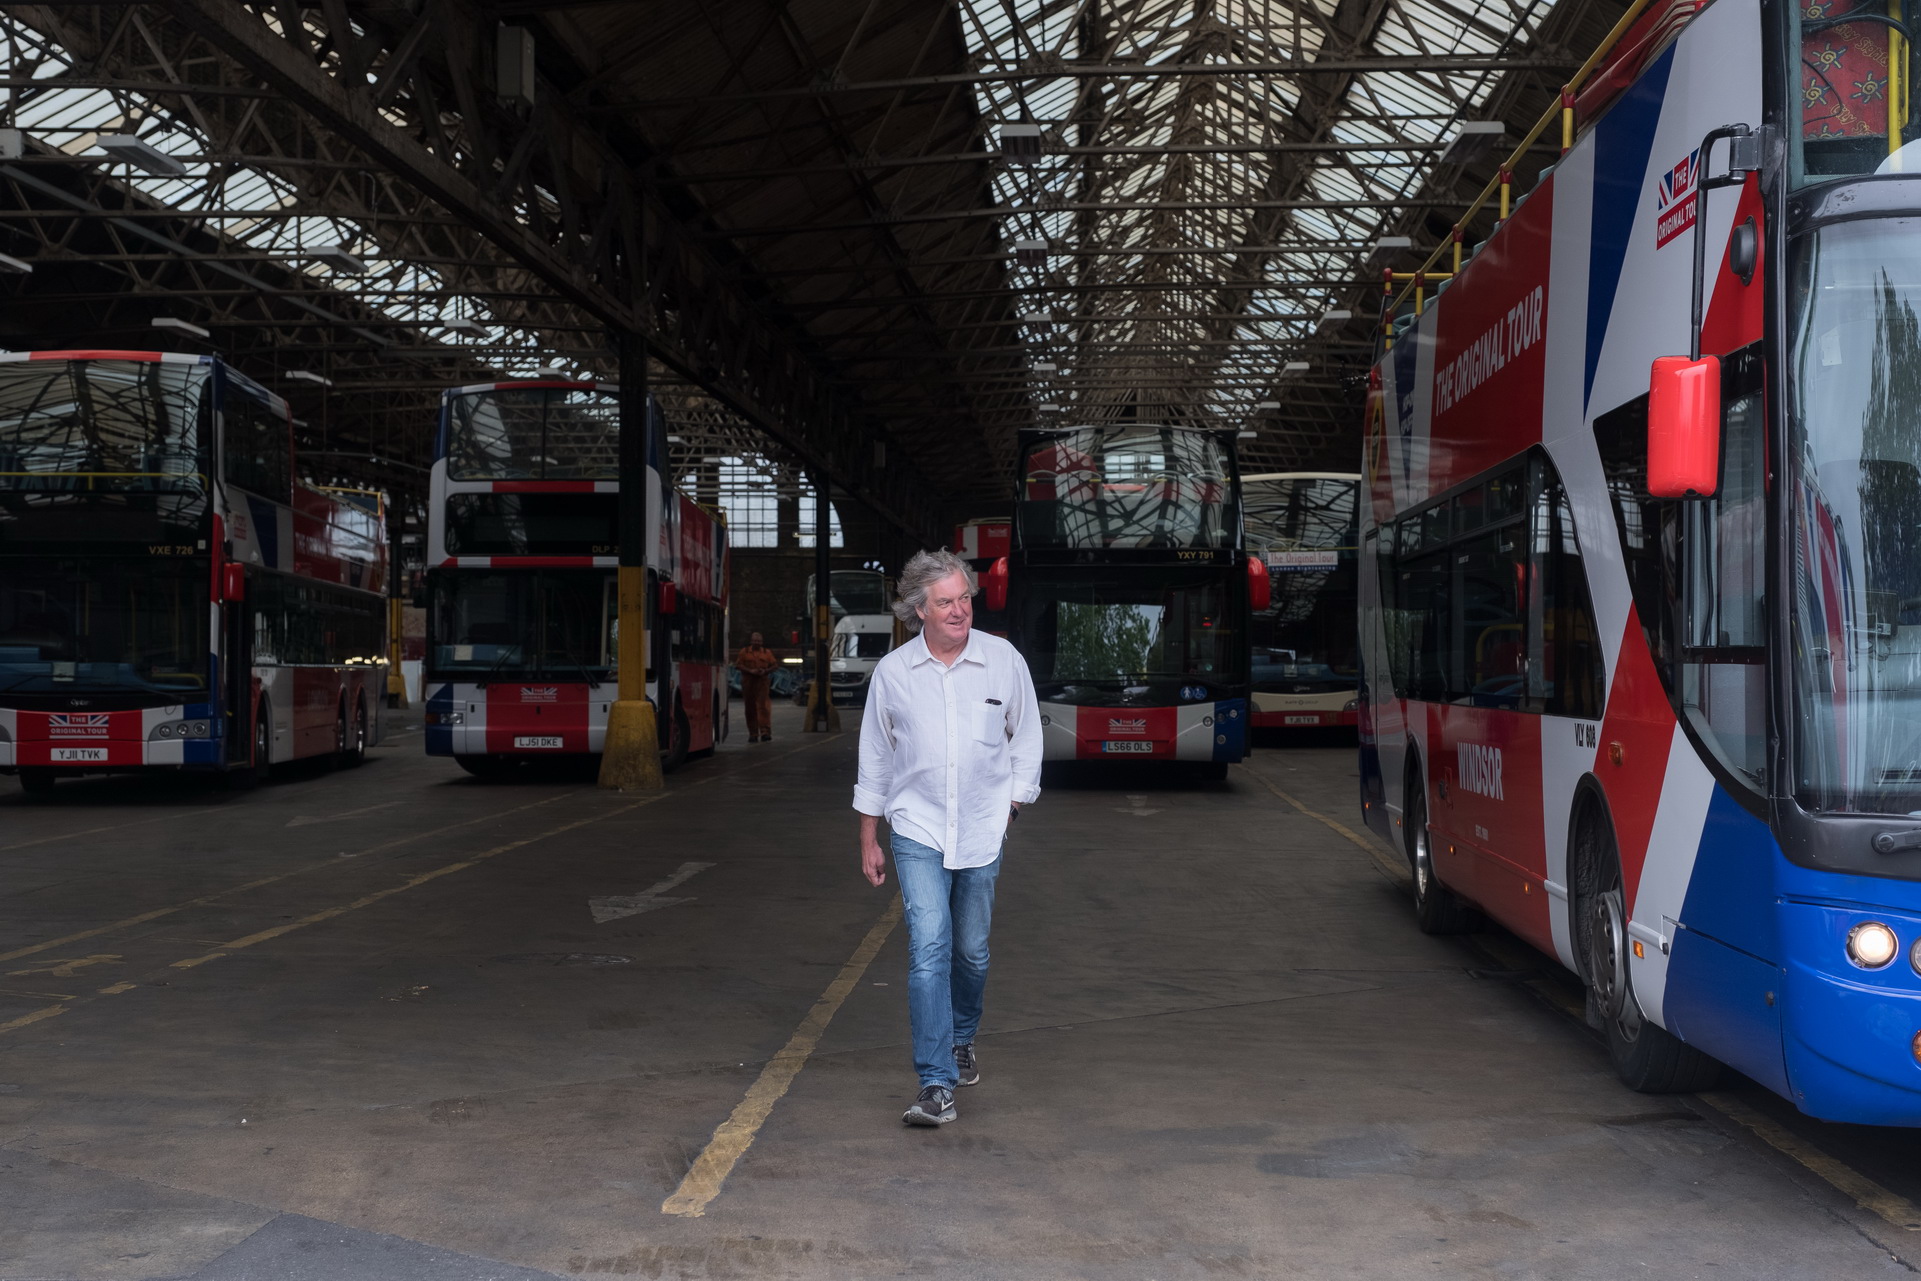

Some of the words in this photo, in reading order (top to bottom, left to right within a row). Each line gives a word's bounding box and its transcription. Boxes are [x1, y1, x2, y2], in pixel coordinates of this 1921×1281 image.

[1675, 165, 1687, 190] THE
[1658, 208, 1684, 242] ORIGINAL
[1436, 361, 1455, 417] THE
[1455, 317, 1505, 403] ORIGINAL
[1507, 285, 1543, 363] TOUR
[148, 545, 172, 555] VXE
[175, 545, 193, 555] 726
[1177, 551, 1197, 560] YXY
[1199, 551, 1215, 560] 791
[1271, 552, 1283, 564] The
[1286, 552, 1317, 566] Original
[1318, 552, 1335, 564] Tour
[1574, 722, 1585, 747] VLY
[519, 738, 539, 747] LJ51
[541, 738, 559, 747] DKE
[1107, 742, 1132, 752] LS66
[1134, 742, 1152, 752] OLS
[80, 750, 100, 760] TVK
[1457, 742, 1504, 801] WINDSOR
